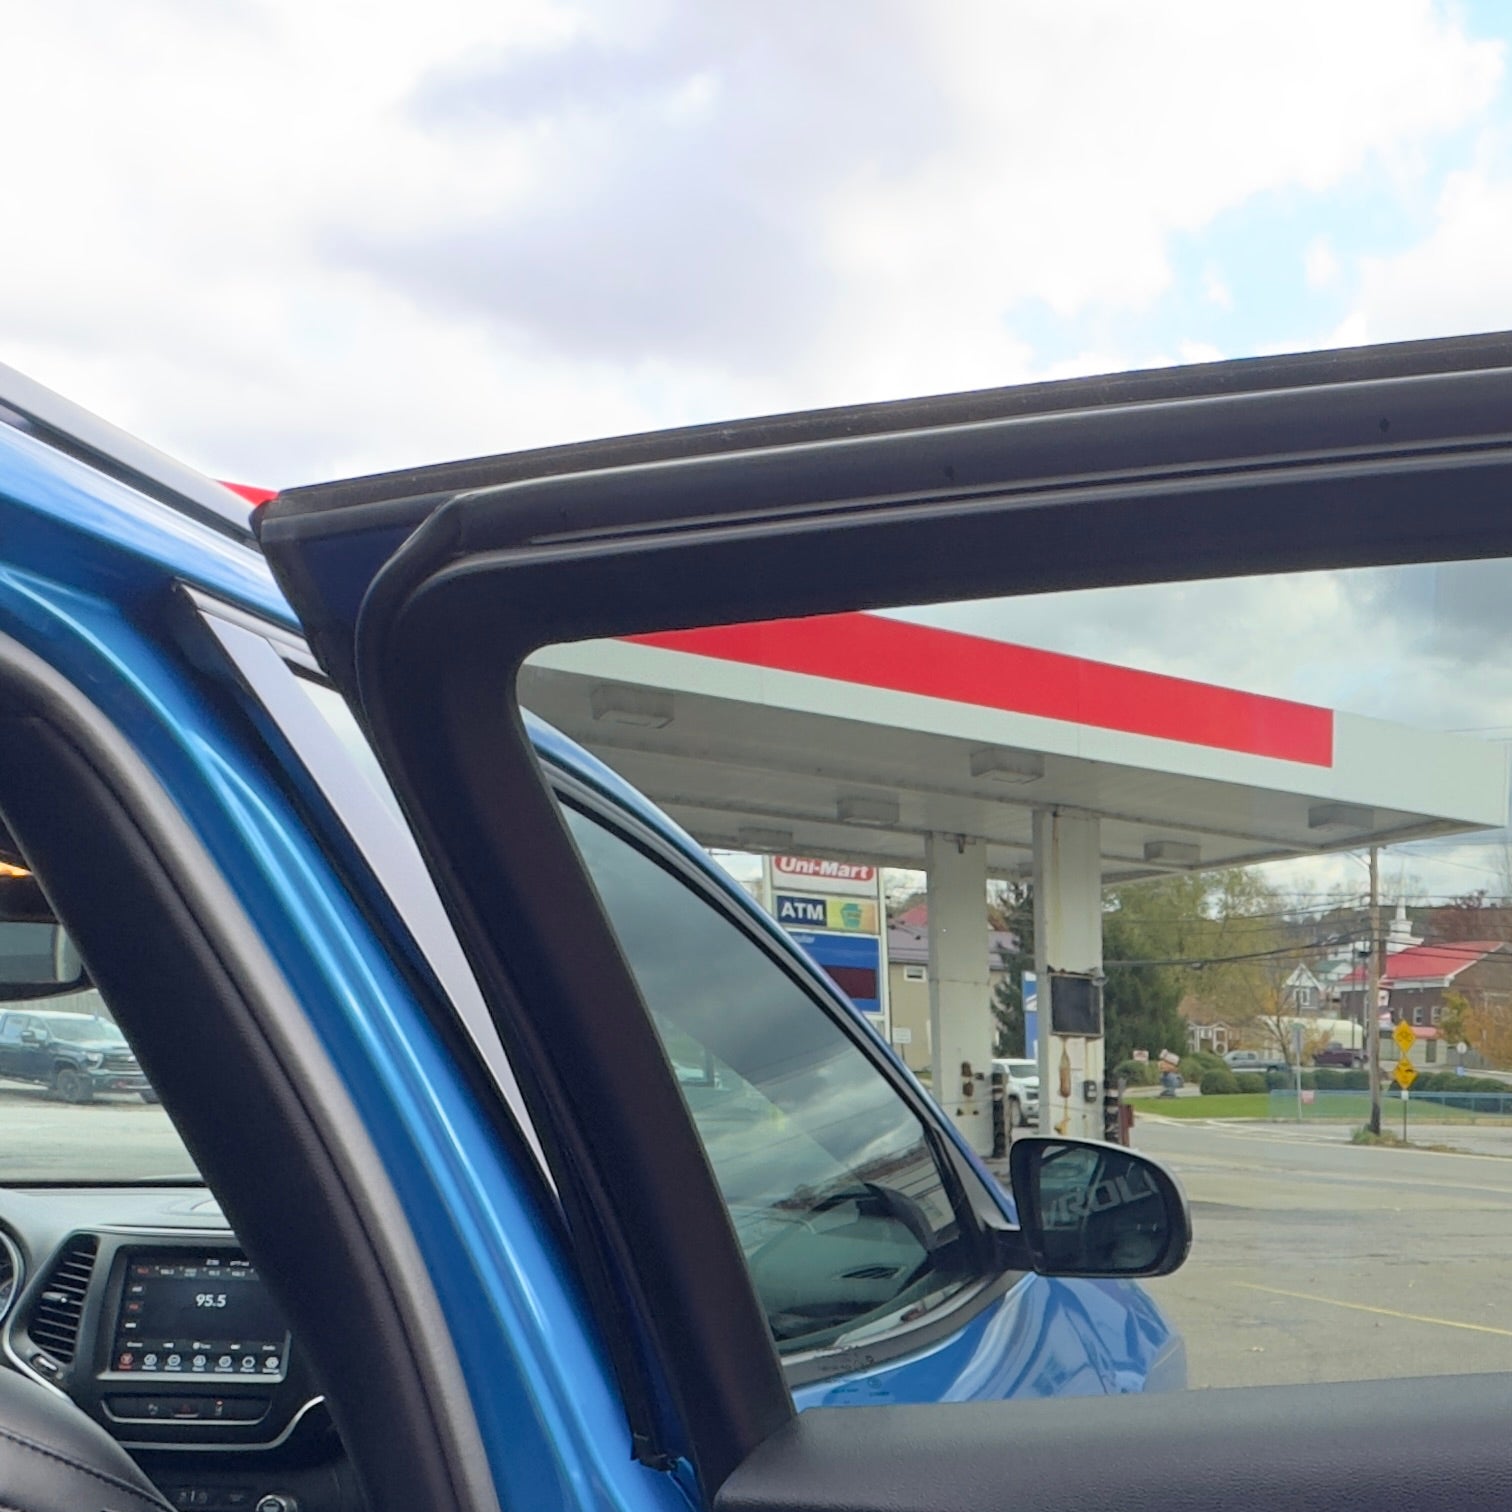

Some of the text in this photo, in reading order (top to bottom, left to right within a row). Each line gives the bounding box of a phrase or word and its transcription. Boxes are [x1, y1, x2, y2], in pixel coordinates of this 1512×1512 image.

[780, 856, 868, 878] Uni-Mart
[781, 902, 824, 921] ATM
[195, 1293, 227, 1308] 95.5
